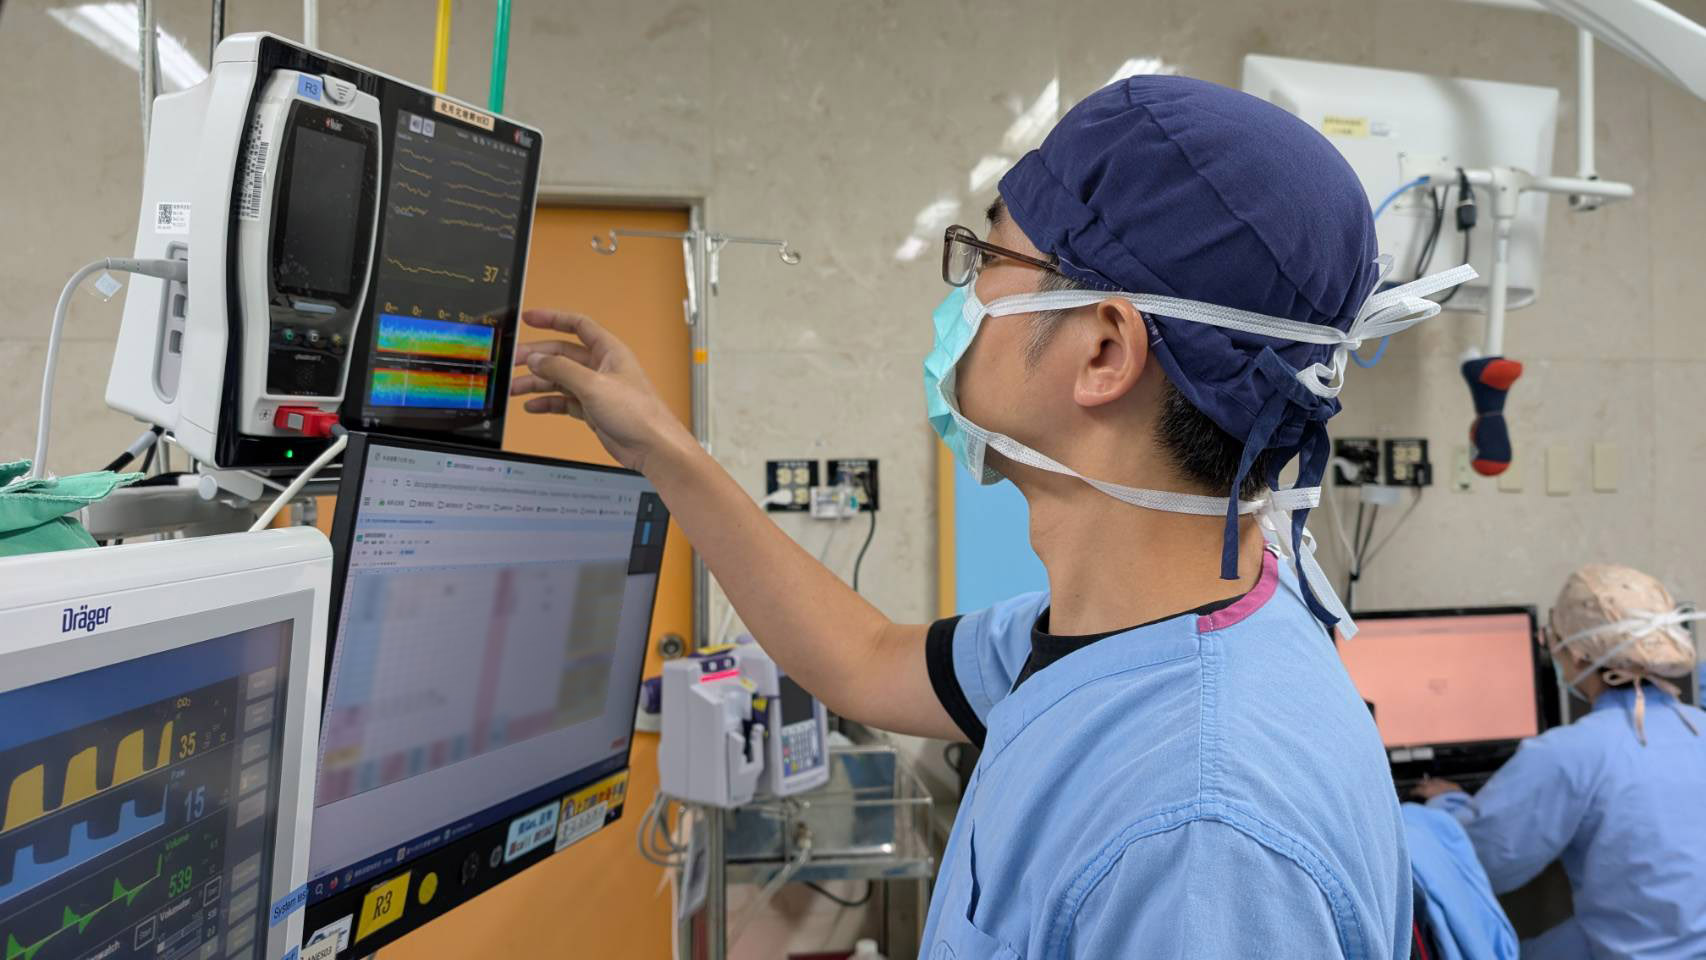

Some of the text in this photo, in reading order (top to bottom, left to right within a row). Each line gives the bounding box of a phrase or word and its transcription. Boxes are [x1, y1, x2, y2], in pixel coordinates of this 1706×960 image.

[304, 81, 319, 96] R3
[482, 264, 499, 283] 37
[62, 604, 112, 633] Dräger
[178, 731, 197, 759] 35
[184, 784, 205, 823] 15
[168, 864, 193, 898] 539
[273, 897, 297, 919] System
[373, 890, 393, 921] R3
